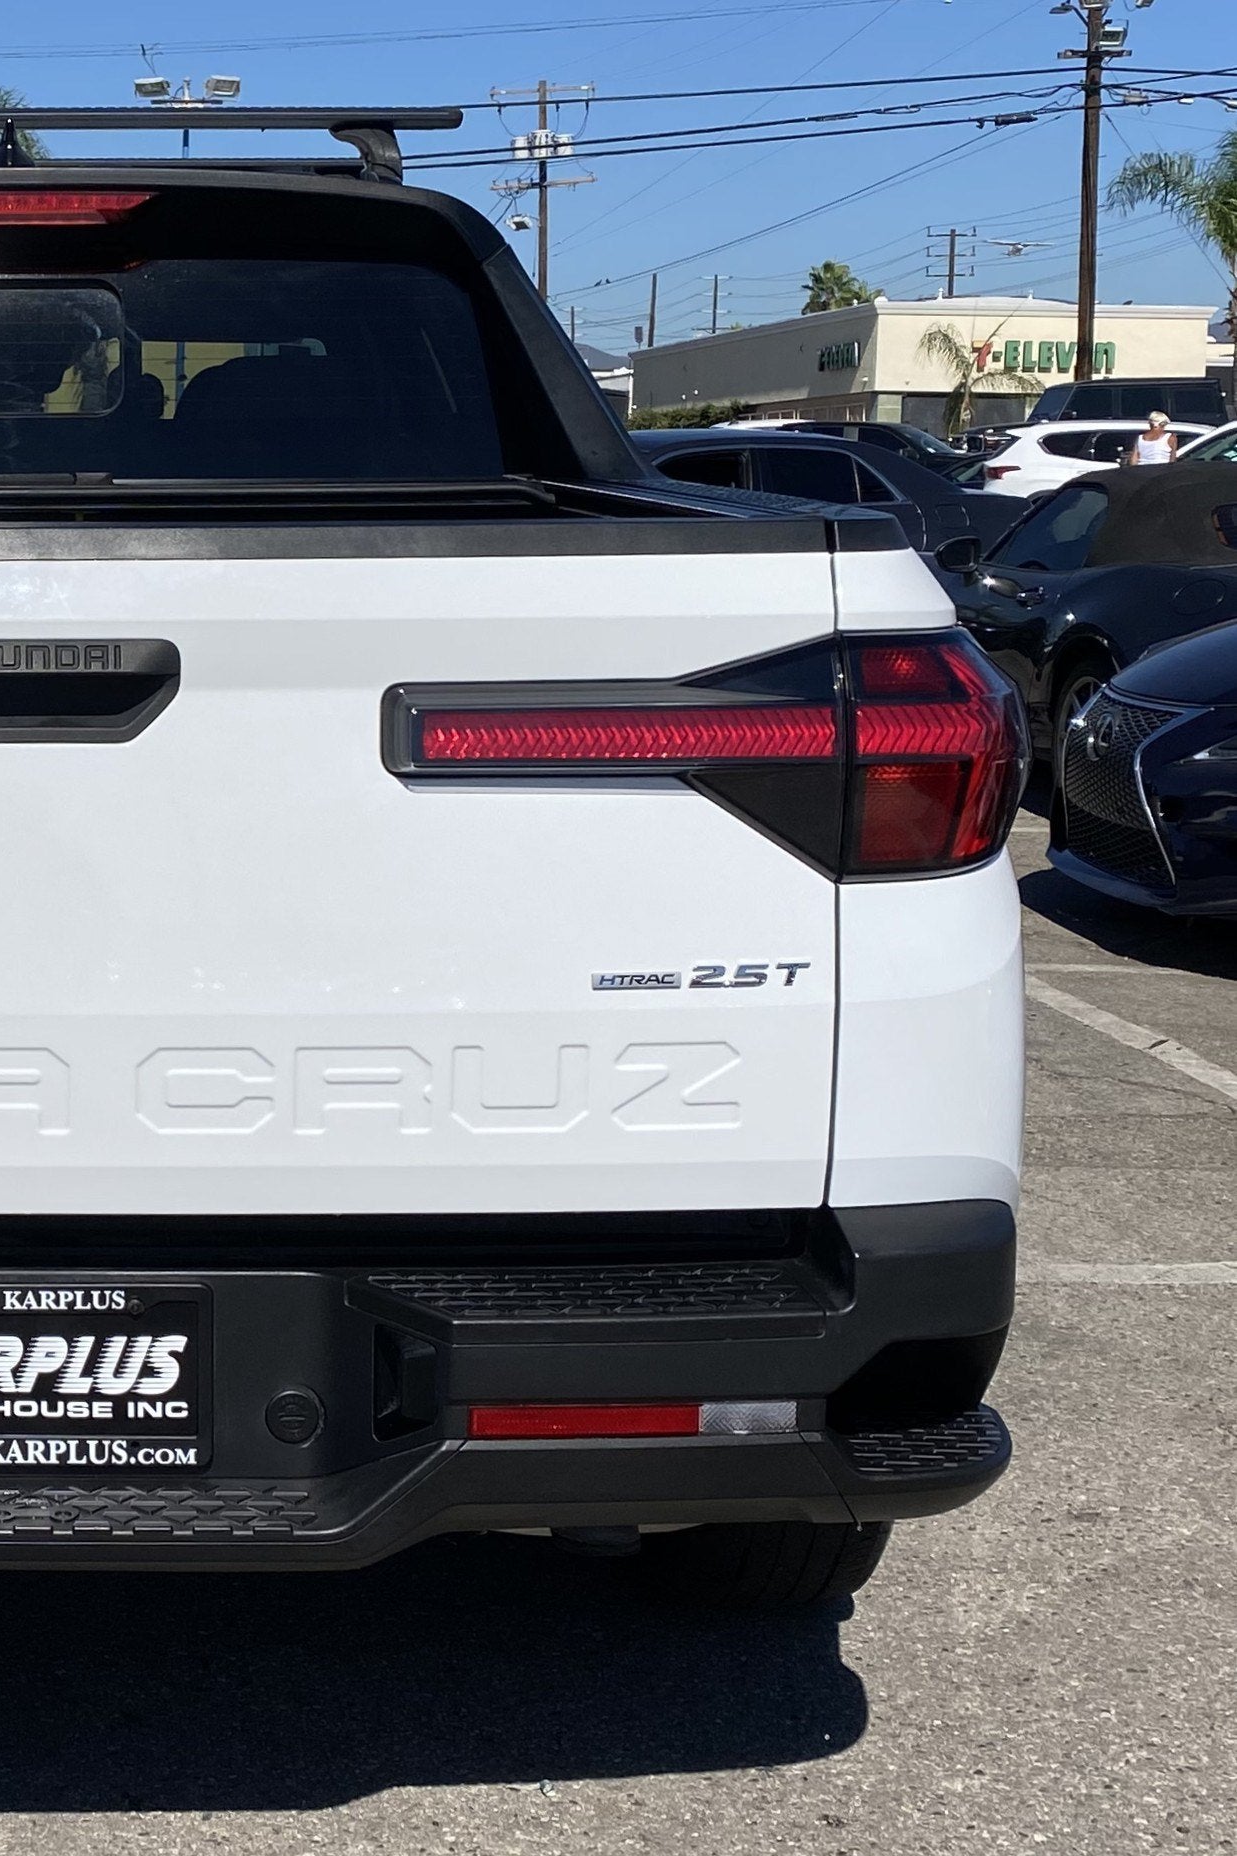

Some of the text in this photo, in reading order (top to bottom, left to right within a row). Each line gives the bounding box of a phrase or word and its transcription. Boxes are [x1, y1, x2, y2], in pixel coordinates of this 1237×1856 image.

[971, 340, 1116, 374] 7-ELEVn
[598, 973, 676, 986] HTRAC
[135, 1042, 742, 1135] CRUZ
[2, 1290, 126, 1310] KARPLUS
[127, 1401, 189, 1418] INC
